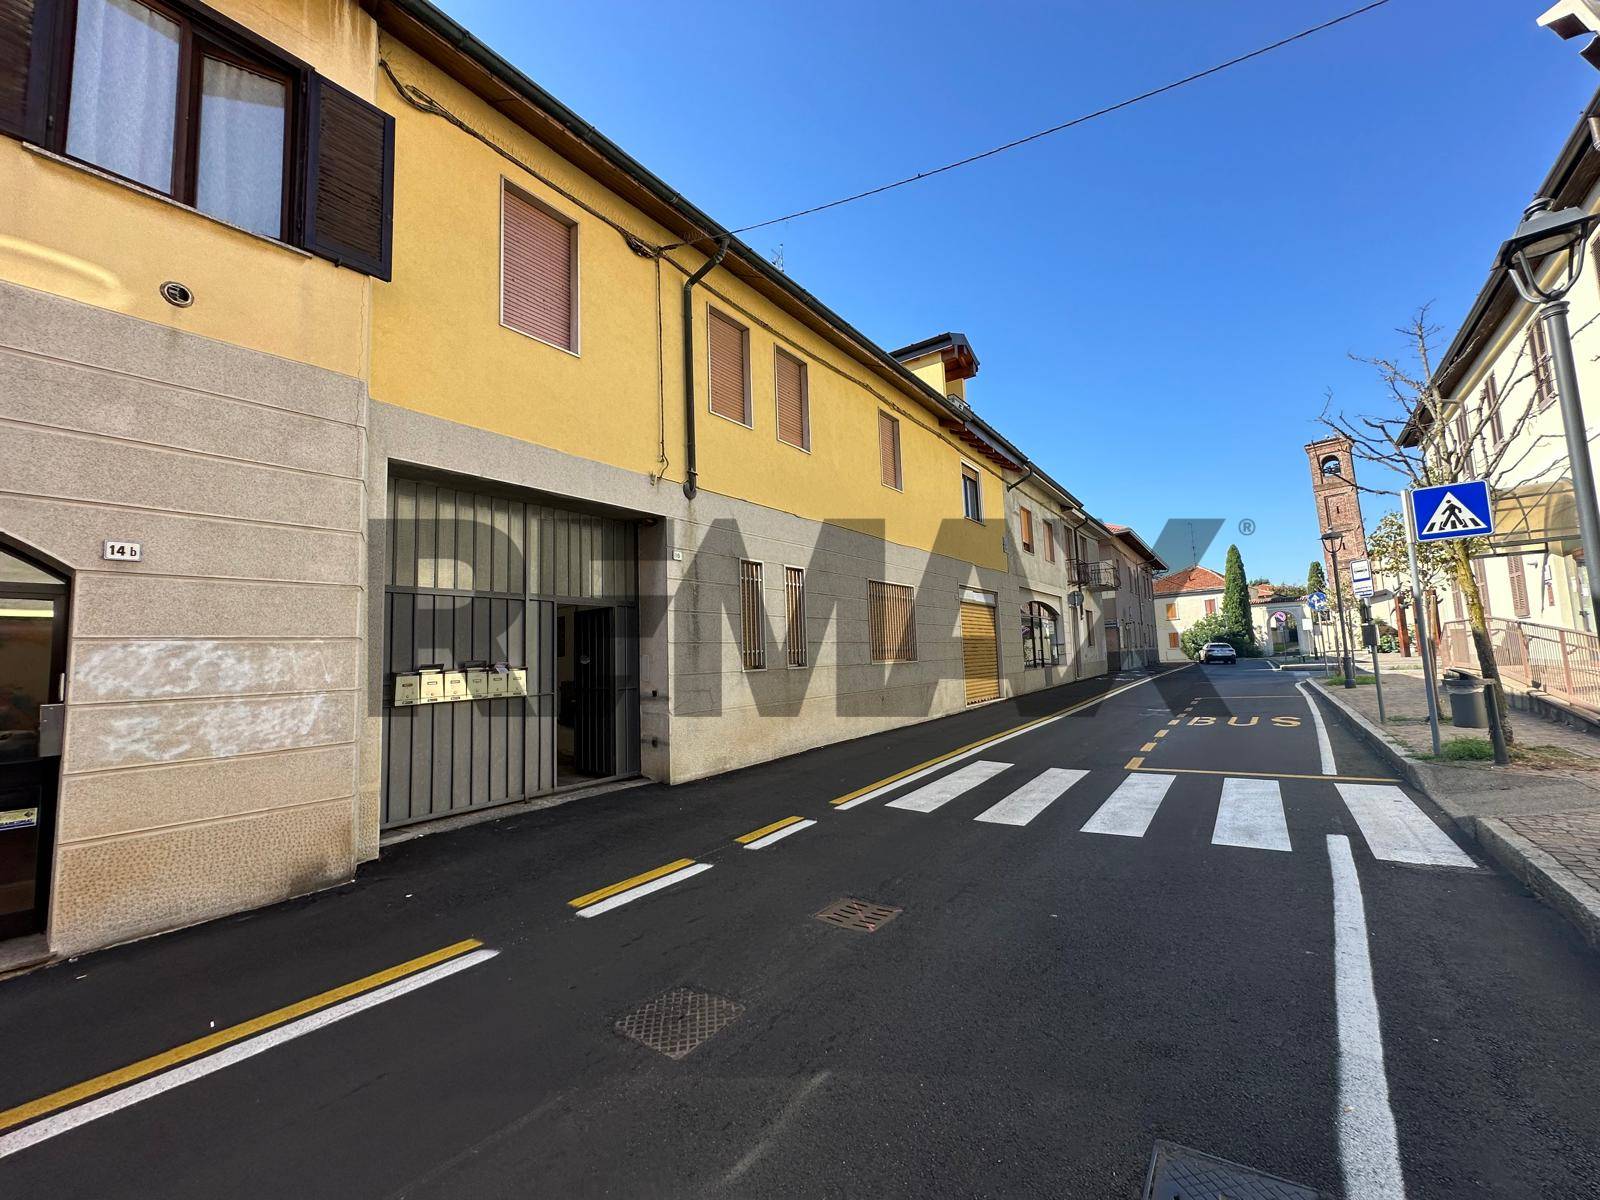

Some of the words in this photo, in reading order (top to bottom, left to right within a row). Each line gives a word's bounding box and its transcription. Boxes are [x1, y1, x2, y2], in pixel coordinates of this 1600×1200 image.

[109, 544, 126, 556] 14
[130, 546, 137, 557] b
[1186, 715, 1302, 728] BUS
